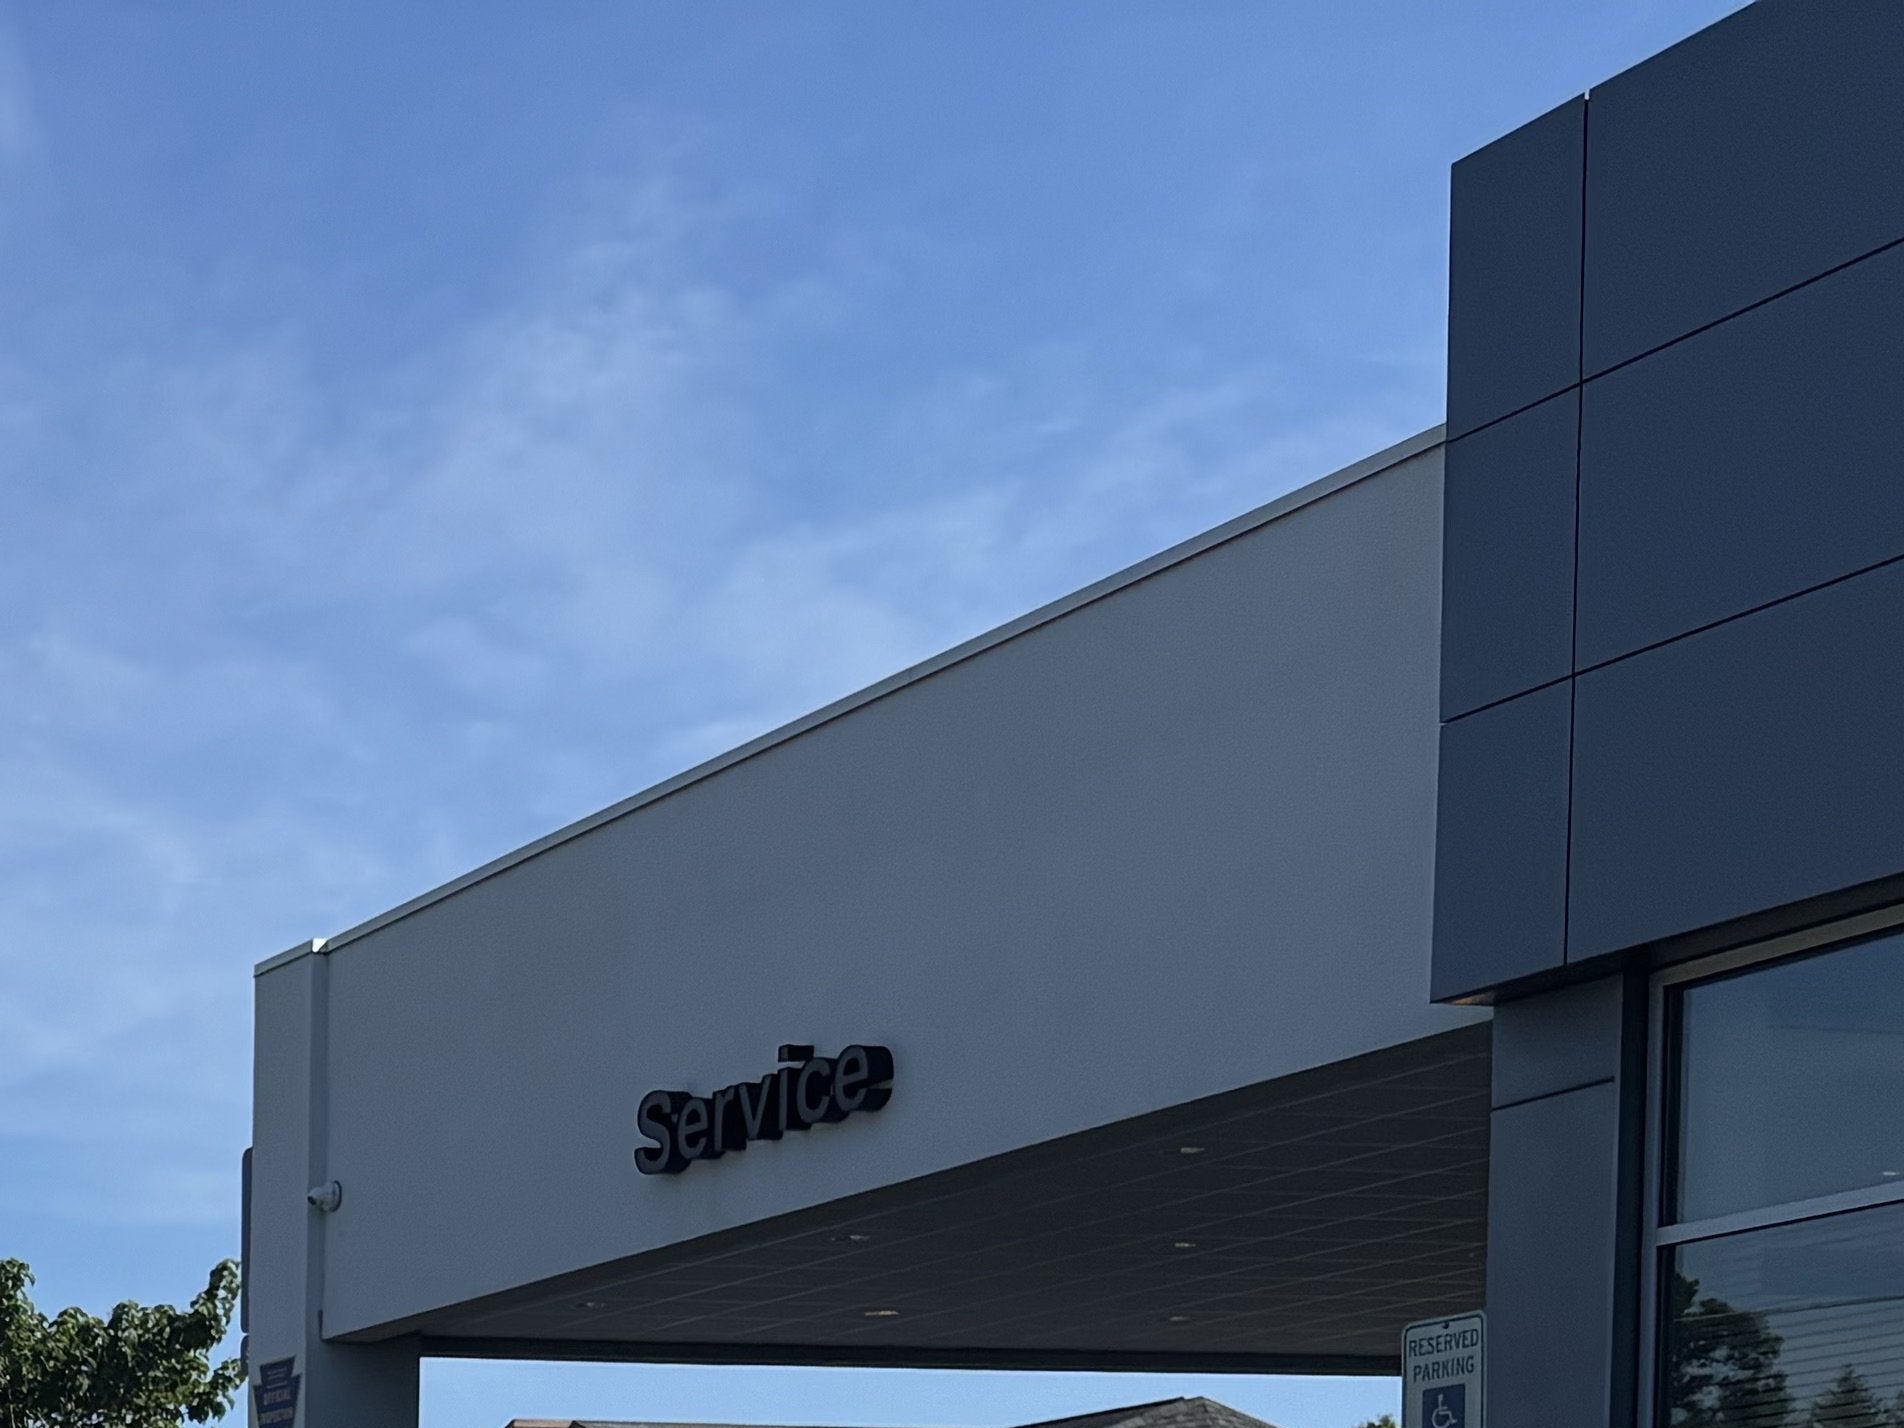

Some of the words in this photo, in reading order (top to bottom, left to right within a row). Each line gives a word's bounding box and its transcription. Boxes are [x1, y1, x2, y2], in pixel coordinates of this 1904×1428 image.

[634, 1043, 895, 1175] Service
[1408, 1328, 1479, 1358] RESERVED
[1413, 1356, 1475, 1383] PARKING
